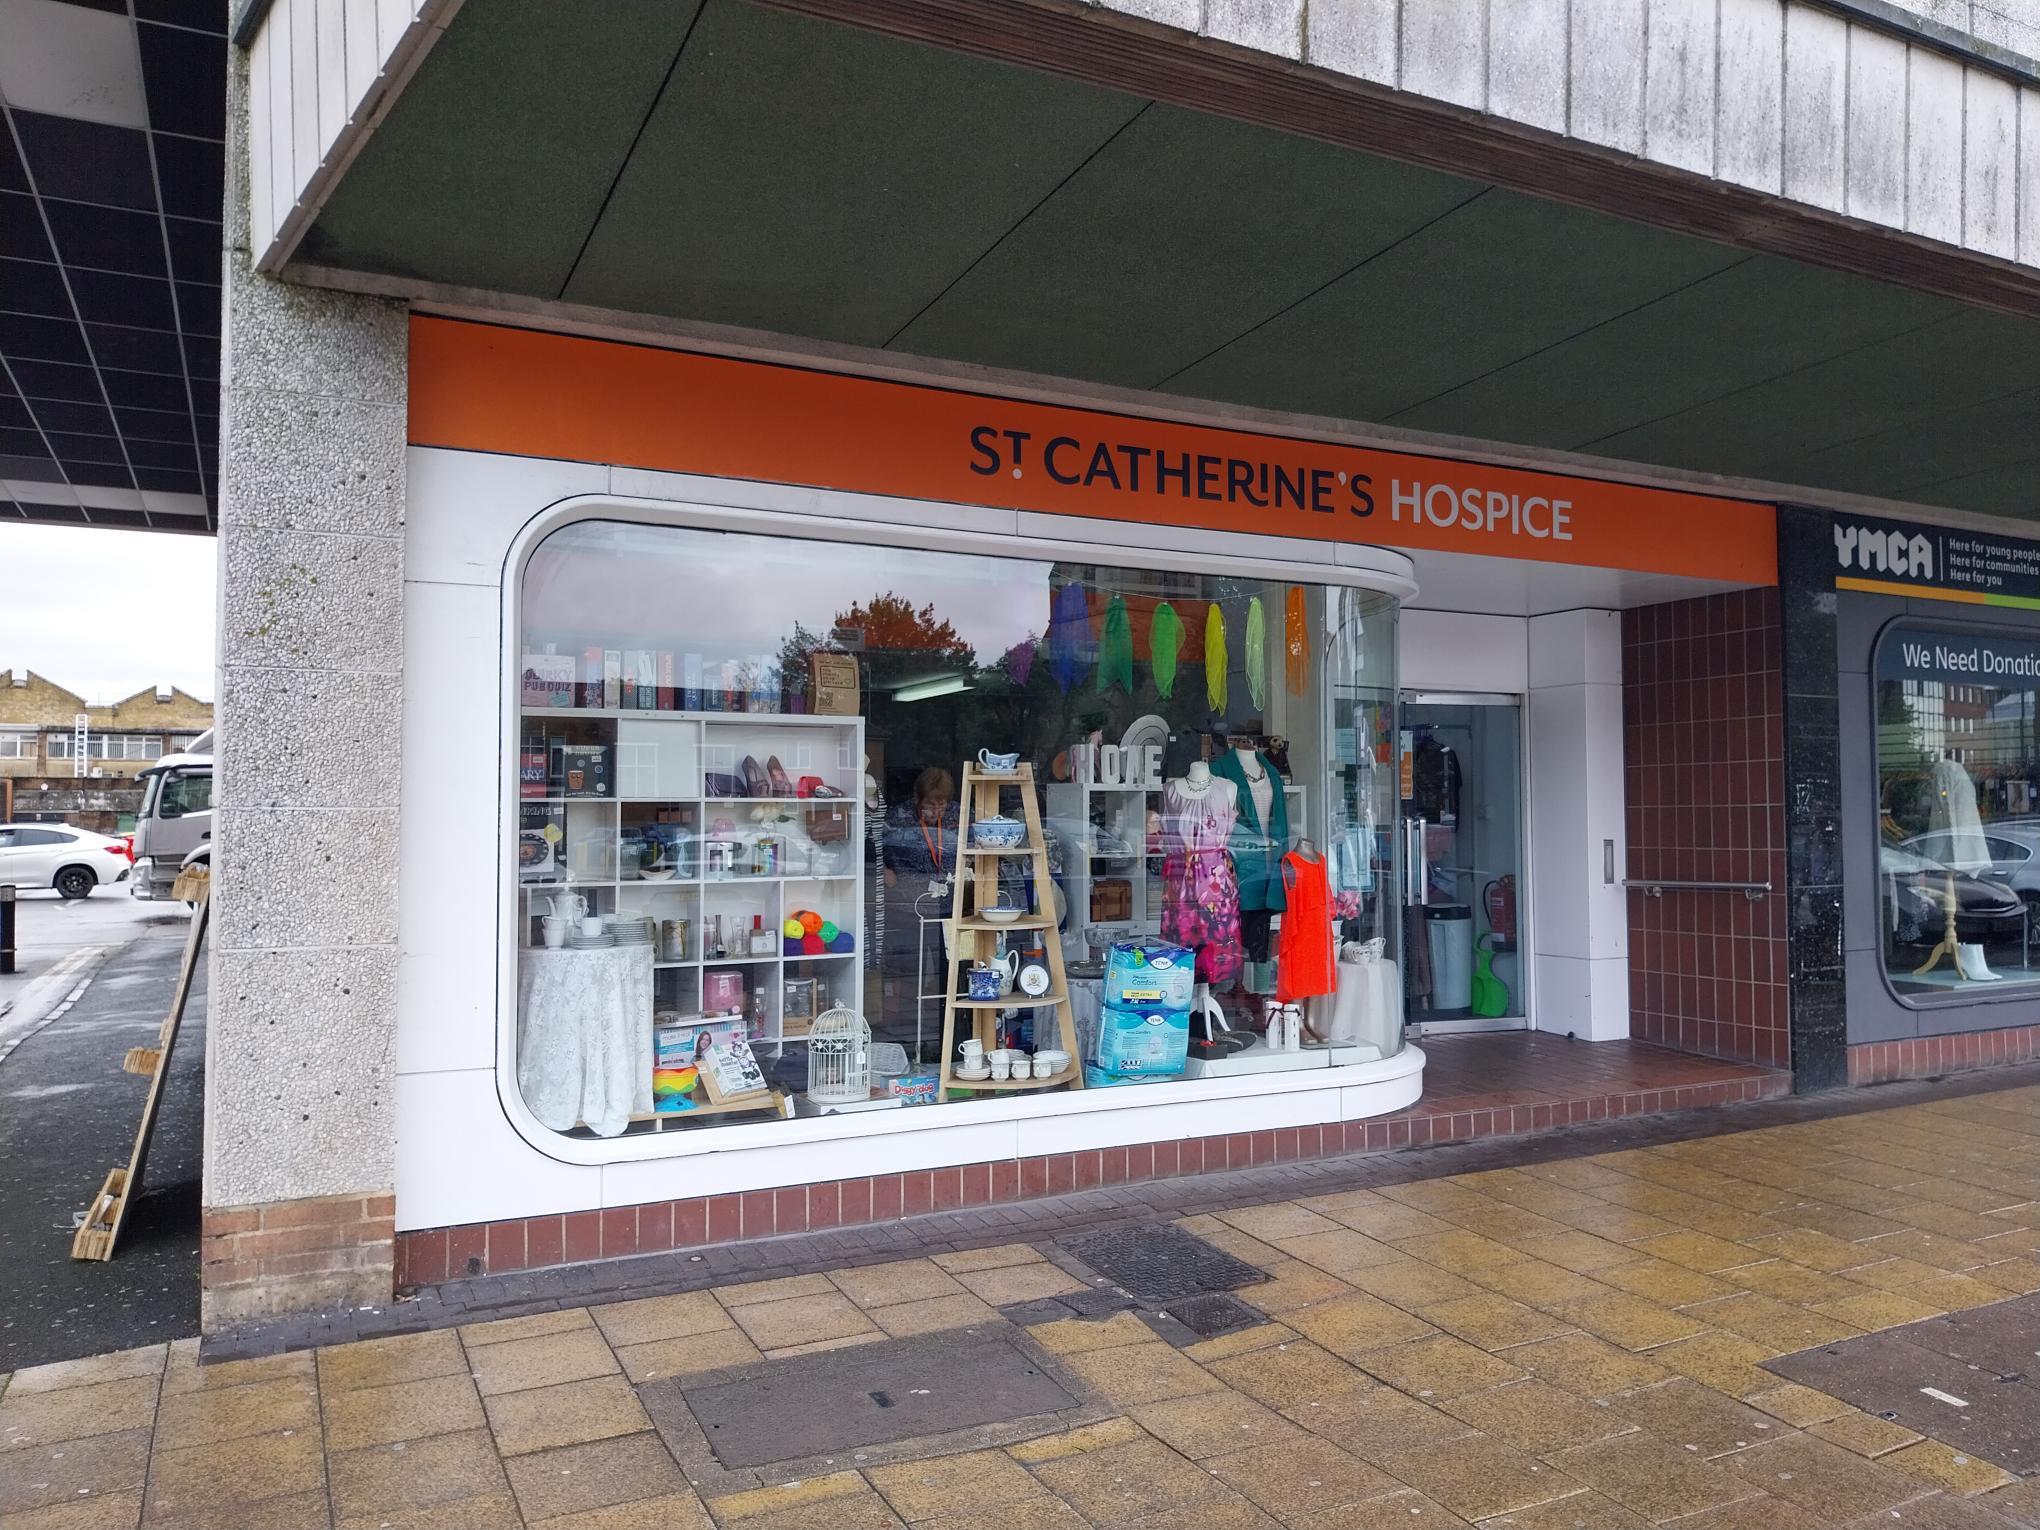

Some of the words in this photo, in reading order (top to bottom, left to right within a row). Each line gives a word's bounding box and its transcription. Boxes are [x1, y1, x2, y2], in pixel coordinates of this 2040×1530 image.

[1043, 435, 1375, 519] CATHERINE'S
[1390, 478, 1574, 542] HOSPICE
[1833, 523, 1933, 580] YMCA
[1949, 537, 1970, 552] Here
[1971, 540, 1985, 554] for
[1985, 545, 2011, 561] young
[2012, 549, 2040, 562] people
[1950, 553, 1971, 567] Here
[1972, 556, 1985, 569] for
[1986, 560, 2039, 576] communities
[1950, 567, 1971, 582] Here
[1972, 570, 1985, 584] for
[1986, 576, 2002, 588] you
[1902, 643, 1931, 670] We
[1935, 646, 1978, 672] Need
[523, 681, 546, 692] PUB
[546, 682, 572, 692] QUIZ
